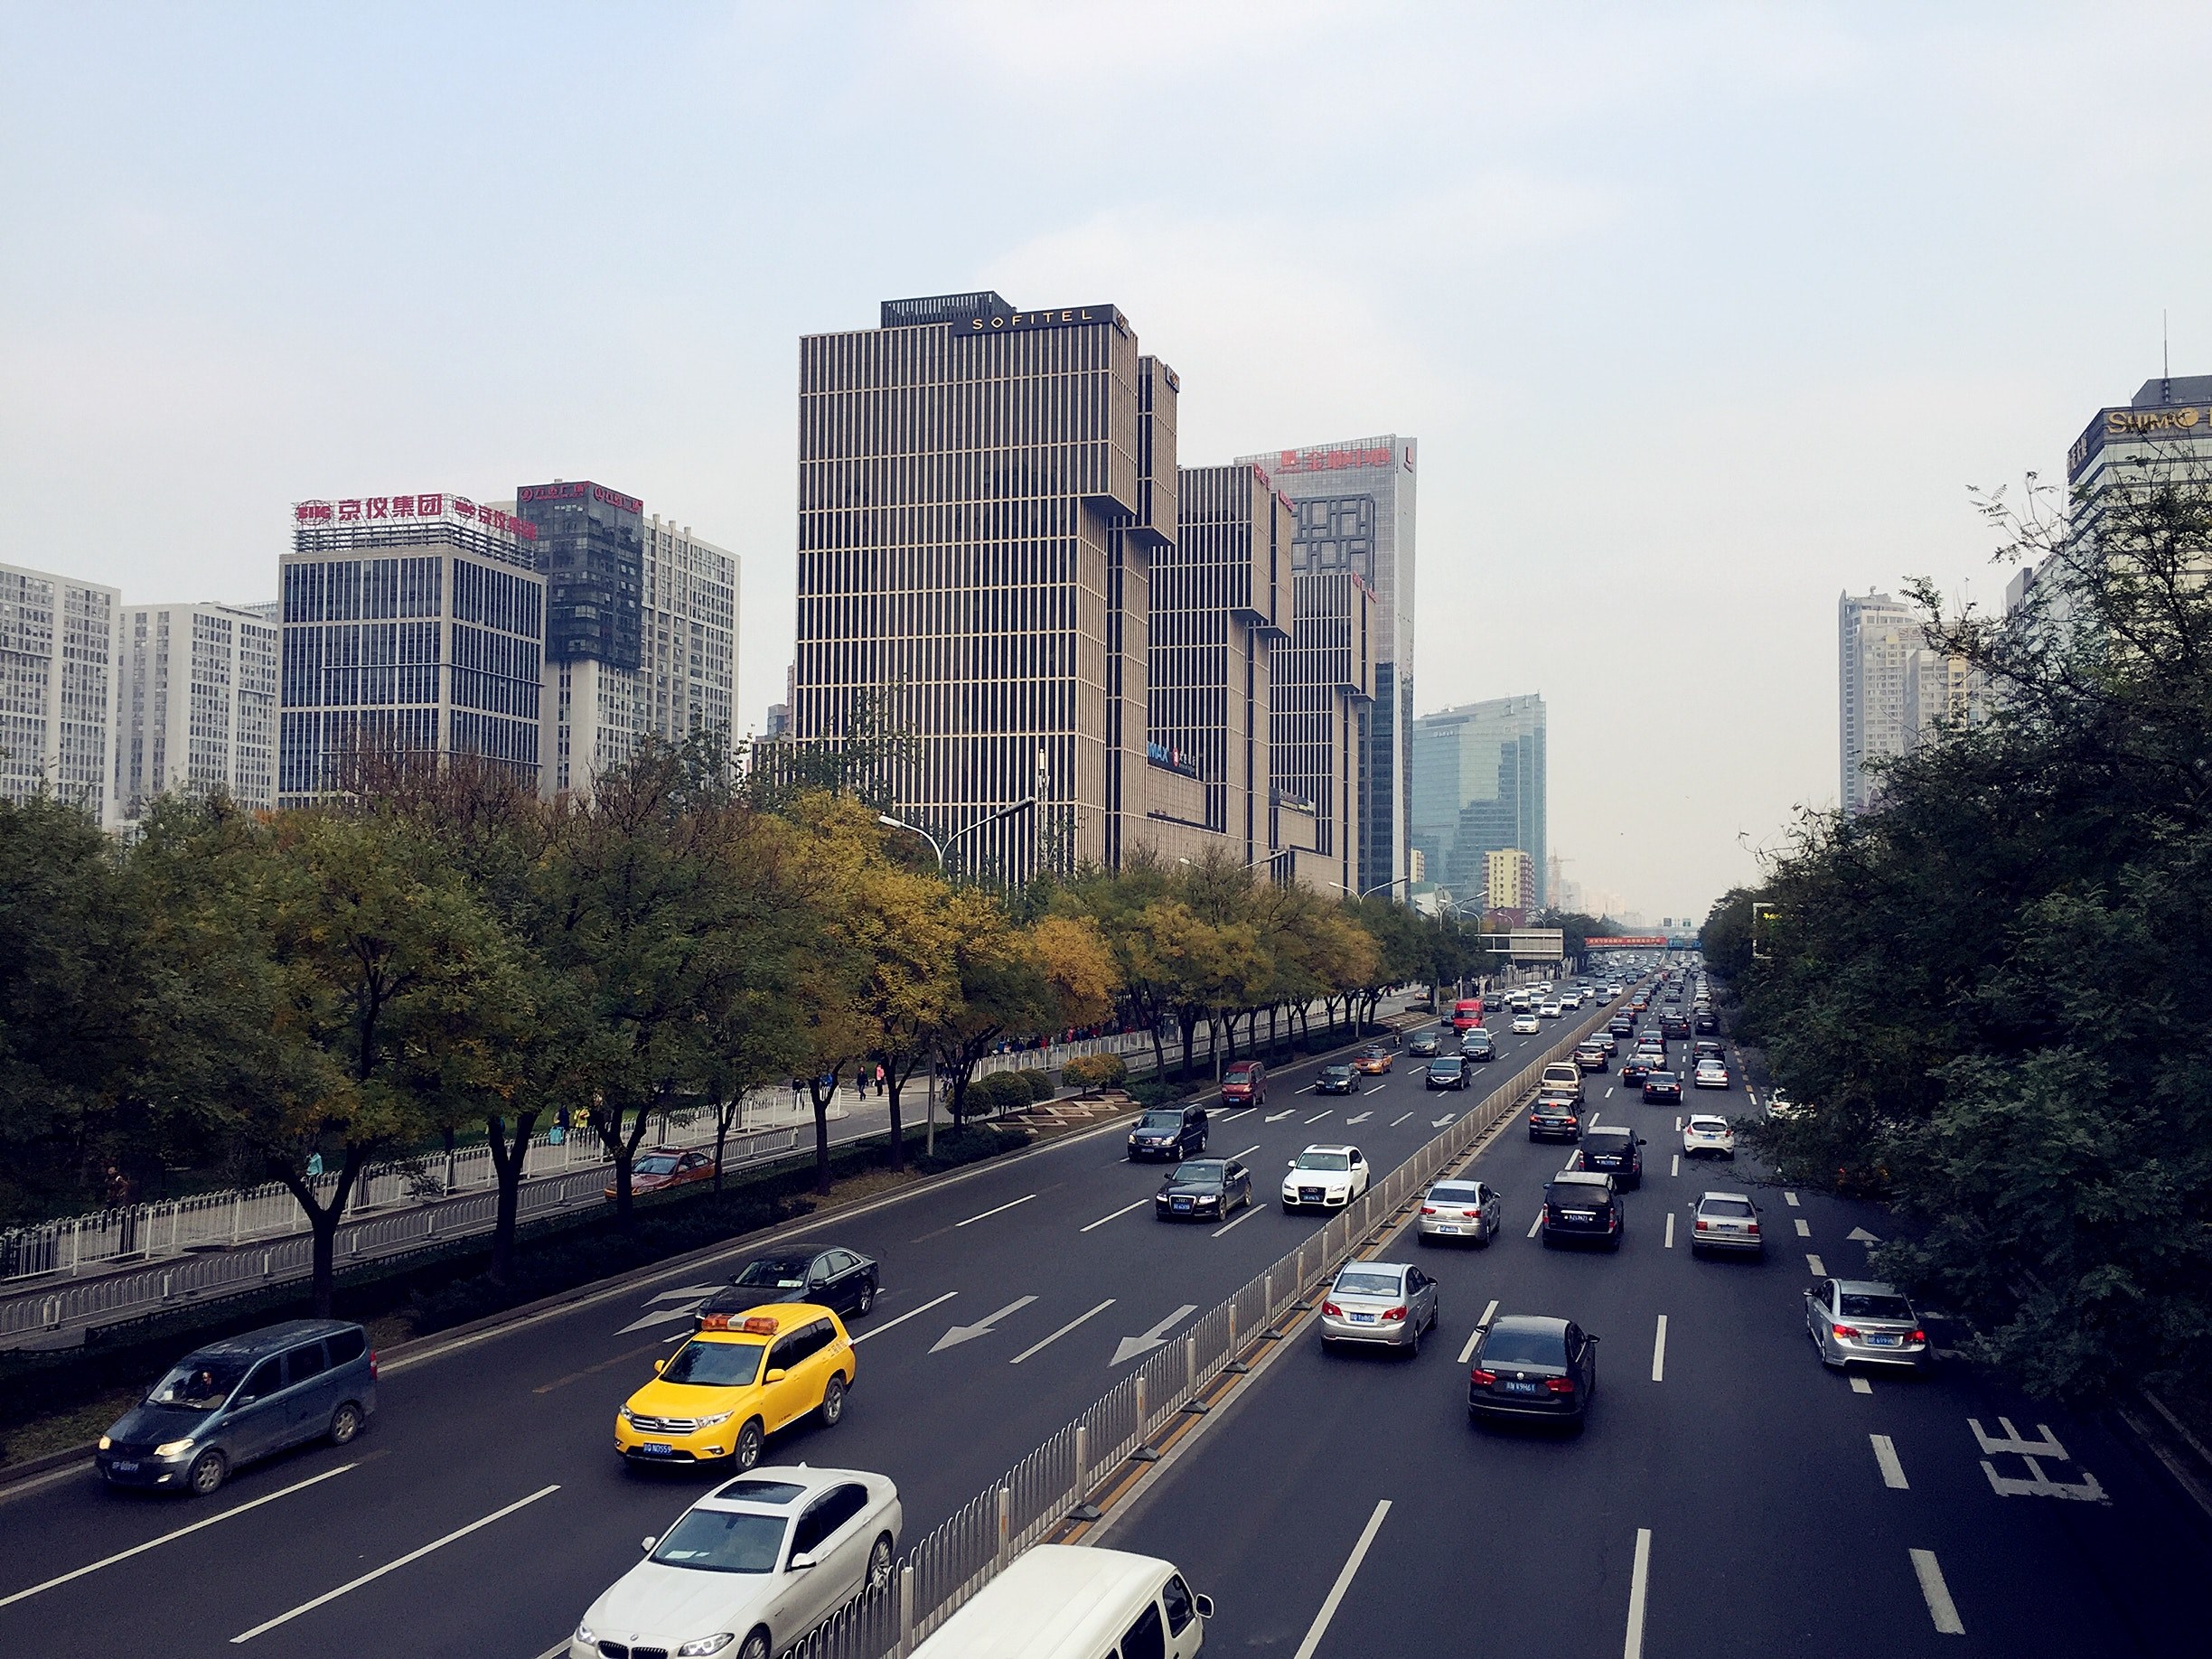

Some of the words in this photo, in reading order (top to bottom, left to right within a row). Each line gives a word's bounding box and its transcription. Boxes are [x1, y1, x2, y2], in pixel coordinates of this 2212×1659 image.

[972, 309, 1092, 329] SOFITEL
[338, 493, 442, 521] 京仪集团
